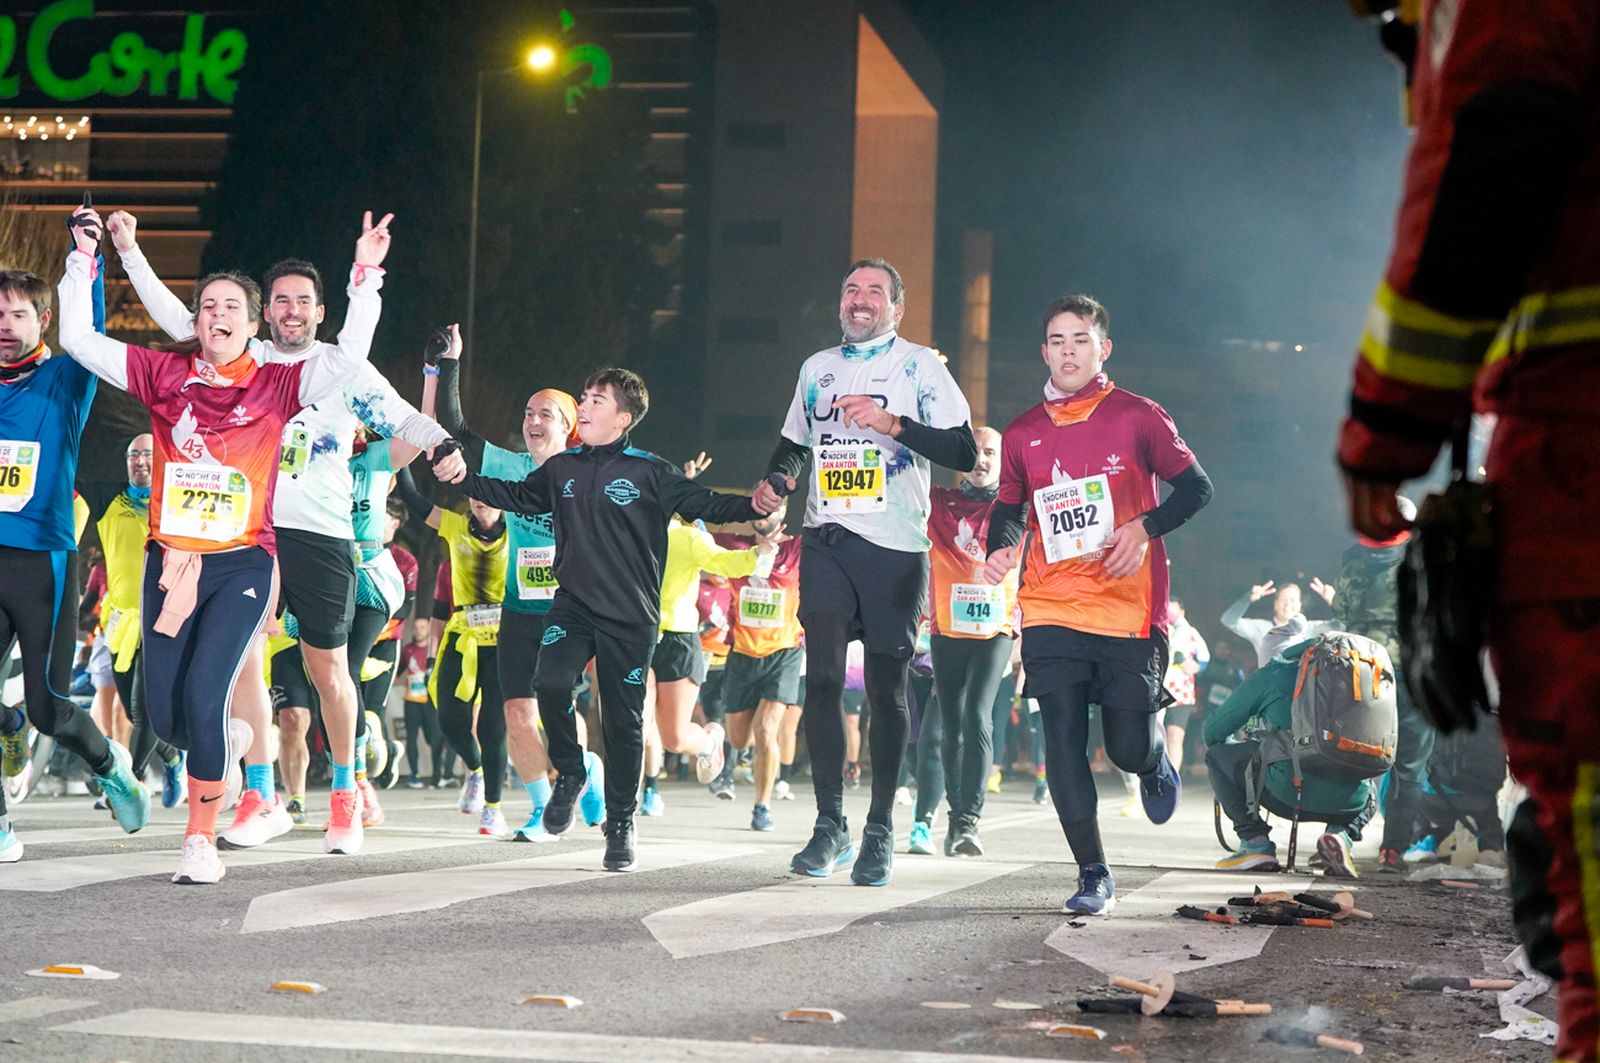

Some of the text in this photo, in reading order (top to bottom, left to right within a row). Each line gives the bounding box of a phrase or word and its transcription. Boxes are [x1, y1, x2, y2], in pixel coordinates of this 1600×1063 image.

[27, 0, 248, 103] Corte
[182, 438, 204, 459] 43
[828, 452, 847, 460] NOCHE
[822, 461, 833, 469] SAN
[825, 469, 875, 491] 12947
[1047, 490, 1069, 503] NOCHE
[1069, 488, 1079, 497] DE
[1050, 504, 1099, 535] 2052
[964, 542, 979, 556] 43
[526, 566, 556, 582] 493
[748, 601, 776, 616] 13717
[966, 602, 991, 617] 414
